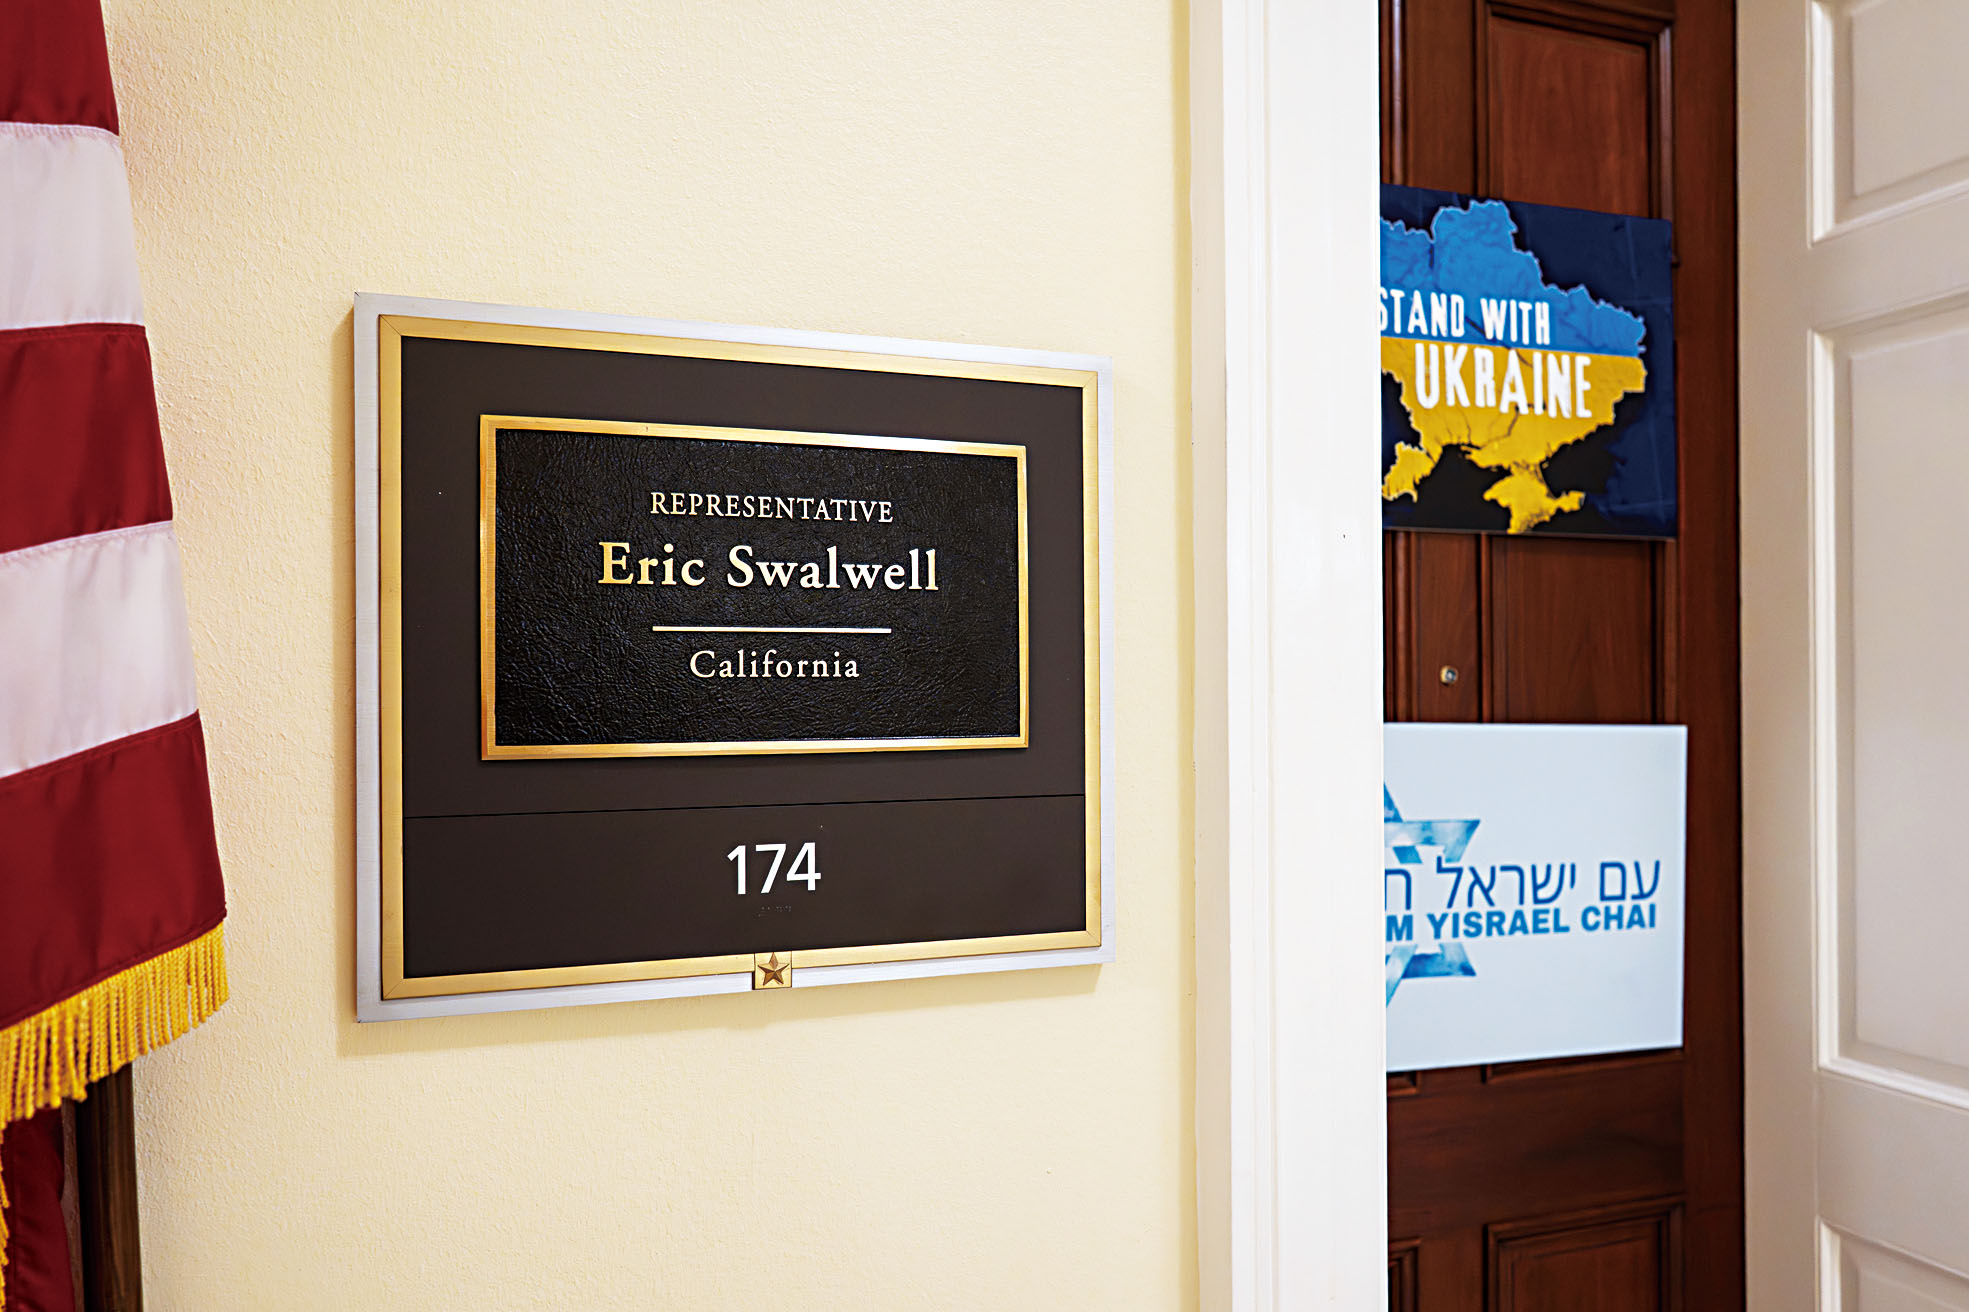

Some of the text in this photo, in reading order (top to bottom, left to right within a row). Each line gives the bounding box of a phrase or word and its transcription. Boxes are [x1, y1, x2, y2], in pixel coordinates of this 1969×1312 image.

[1480, 298, 1550, 346] WITH
[1415, 343, 1593, 419] UKRAINE
[650, 492, 894, 523] REPRESENTATIVE
[598, 542, 939, 591] Eric Swalwell
[689, 649, 860, 678] California
[727, 842, 822, 895] 174
[1385, 855, 1661, 911] עם ישראל ח
[1385, 903, 1657, 942] M YISRAEL CHAI
